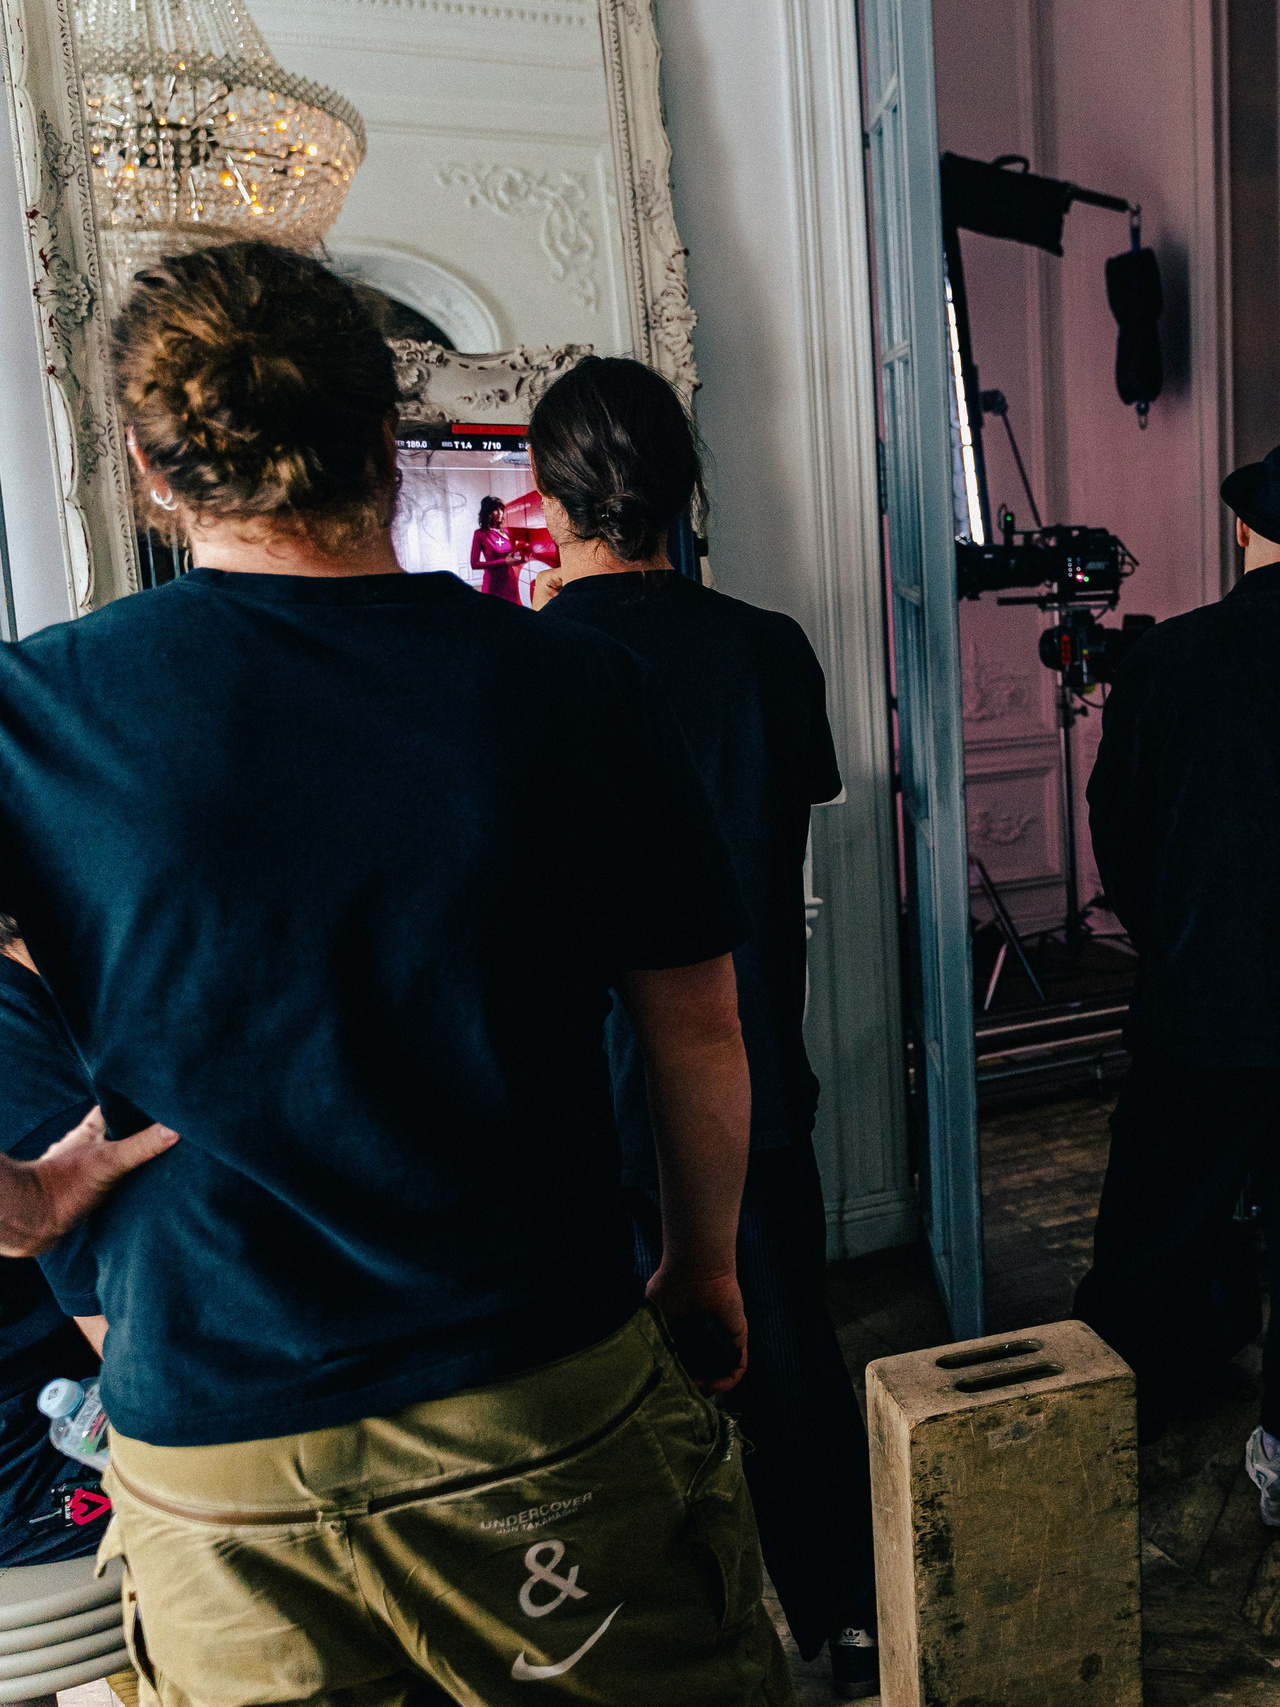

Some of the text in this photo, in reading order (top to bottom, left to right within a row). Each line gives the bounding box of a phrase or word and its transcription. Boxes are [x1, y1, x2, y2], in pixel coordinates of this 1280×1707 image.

[453, 441, 460, 449] T
[482, 441, 502, 450] 7/10
[480, 1491, 593, 1531] UNDERCOVER
